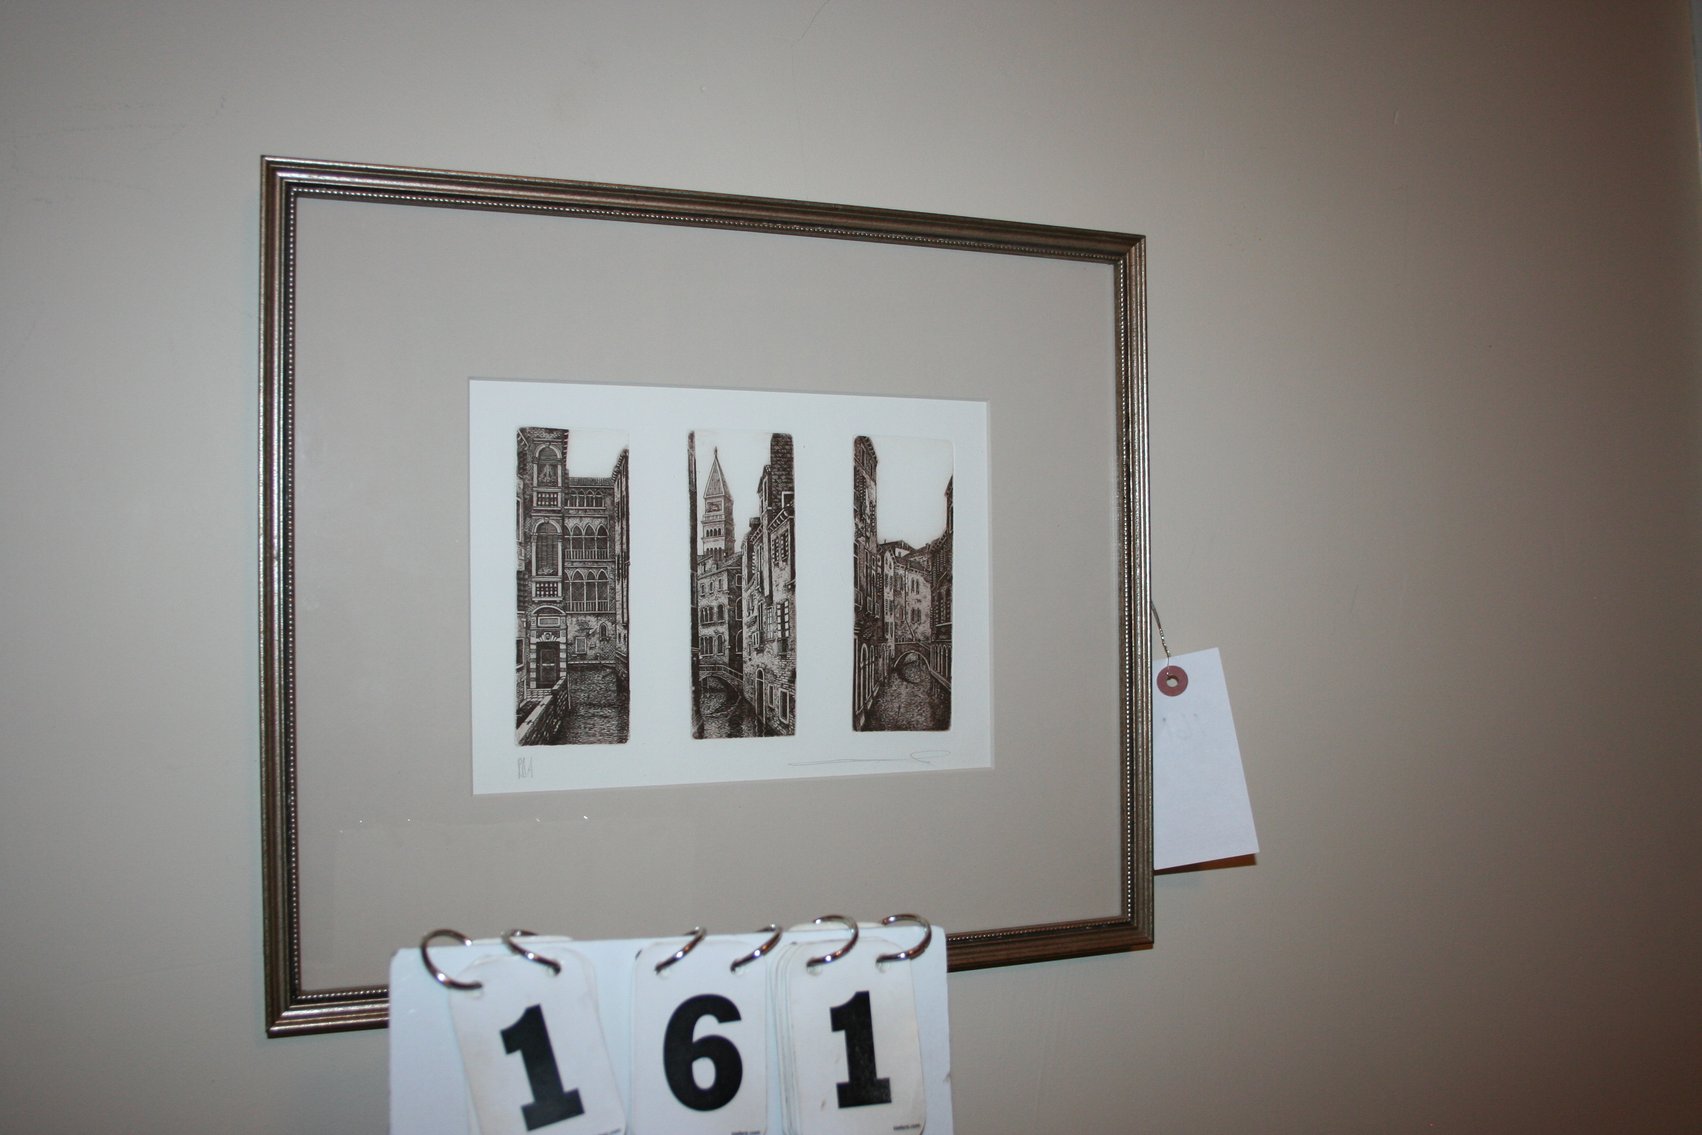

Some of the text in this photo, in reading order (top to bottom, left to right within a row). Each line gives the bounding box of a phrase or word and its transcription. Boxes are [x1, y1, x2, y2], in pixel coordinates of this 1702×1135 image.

[501, 991, 892, 1131] 1 6 1
